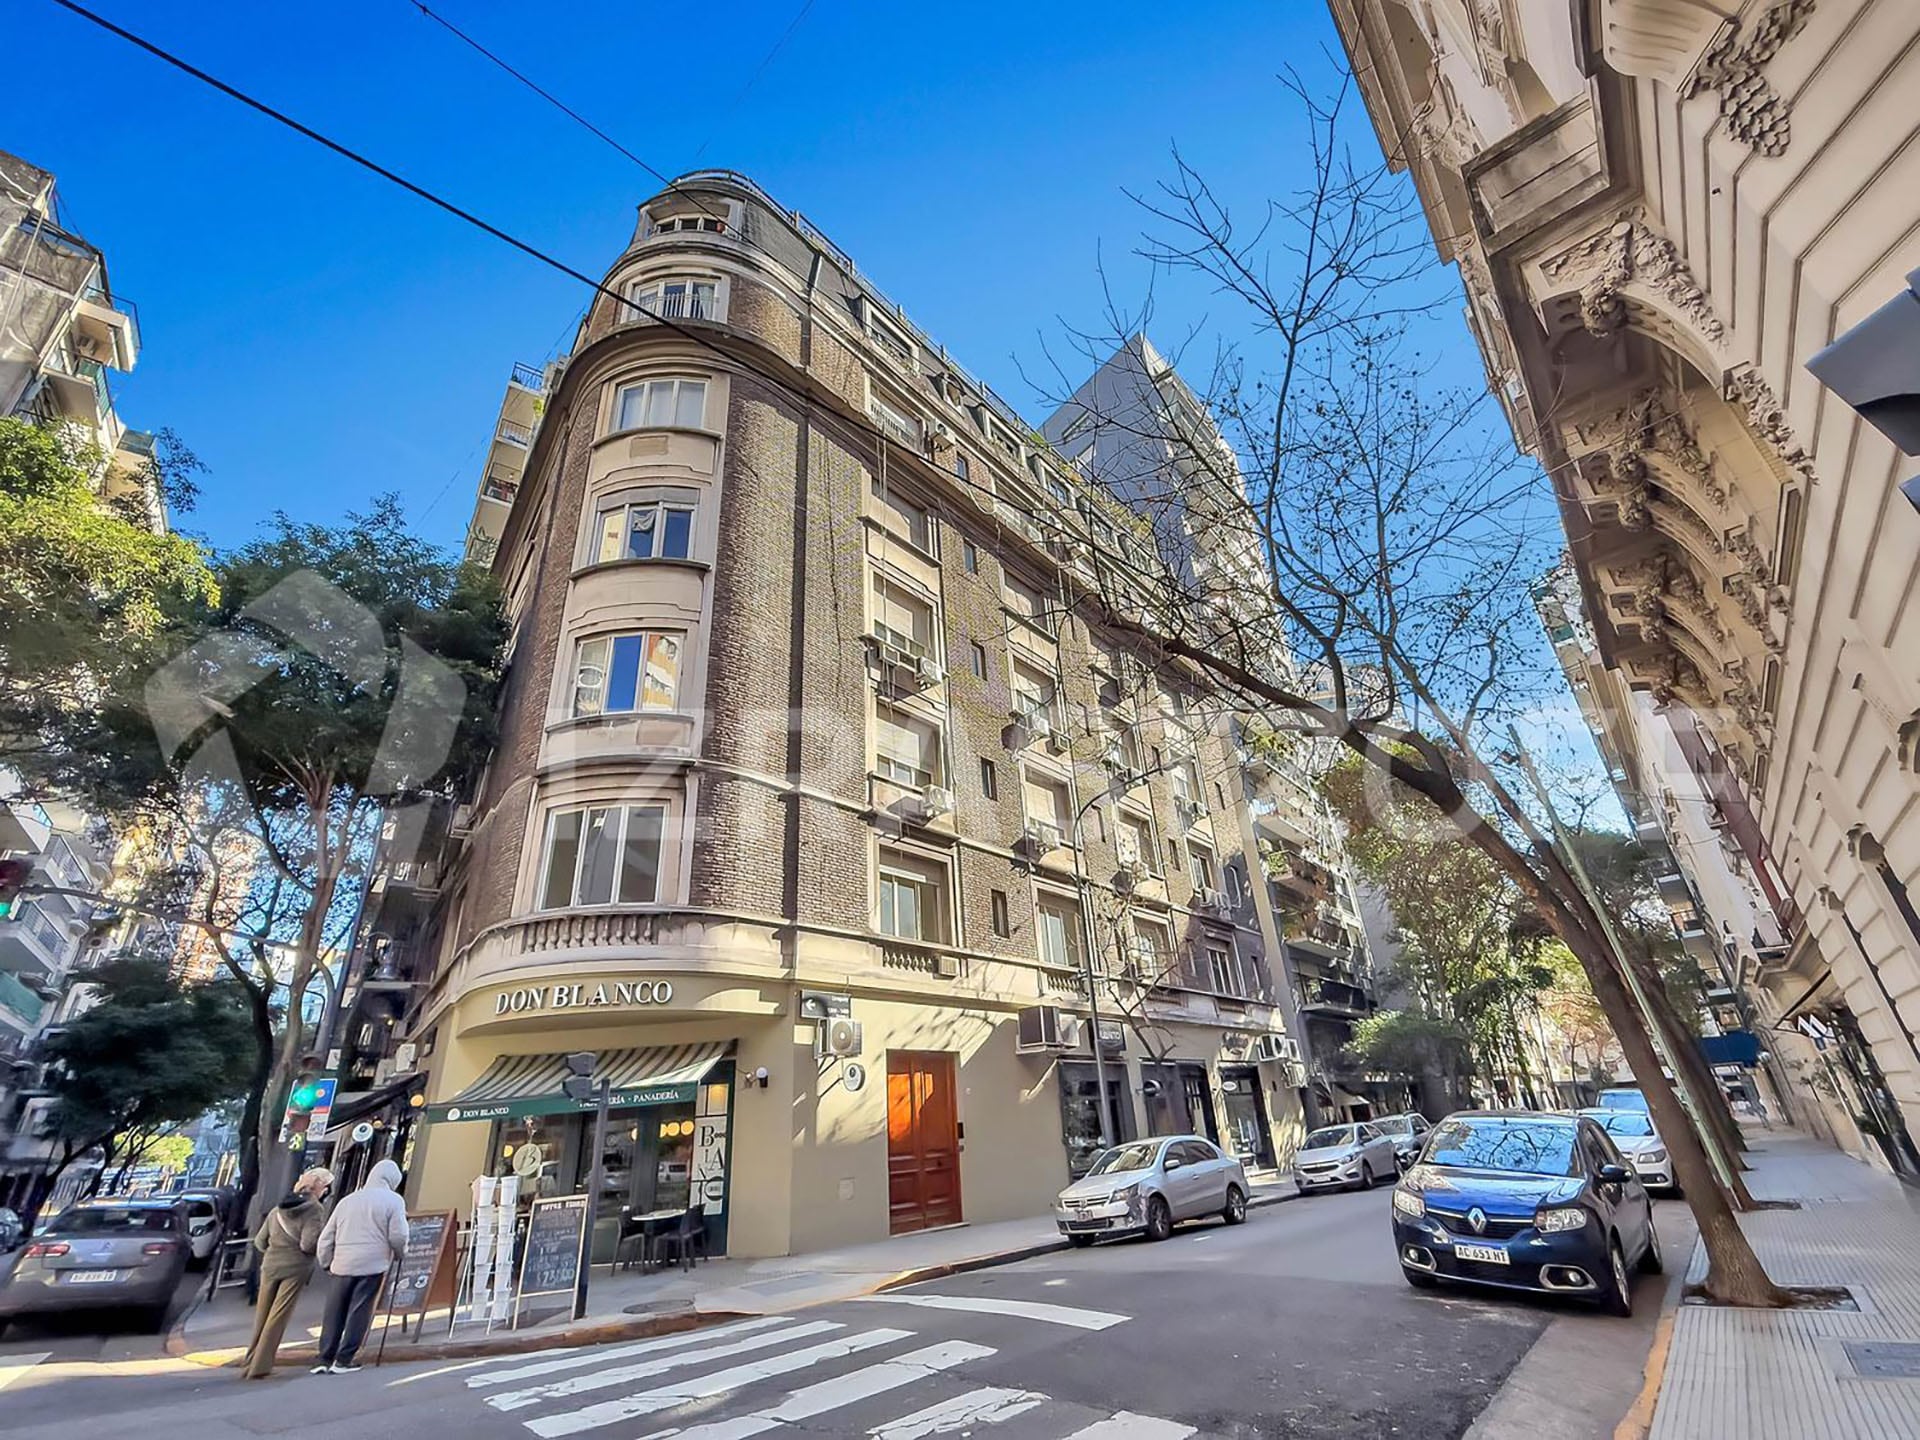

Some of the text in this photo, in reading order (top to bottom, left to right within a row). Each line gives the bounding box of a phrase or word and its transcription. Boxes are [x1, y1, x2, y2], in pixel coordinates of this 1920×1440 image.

[495, 979, 673, 1016] DON BLANCO
[463, 1110, 480, 1118] DON
[1473, 1249, 1491, 1260] 651
